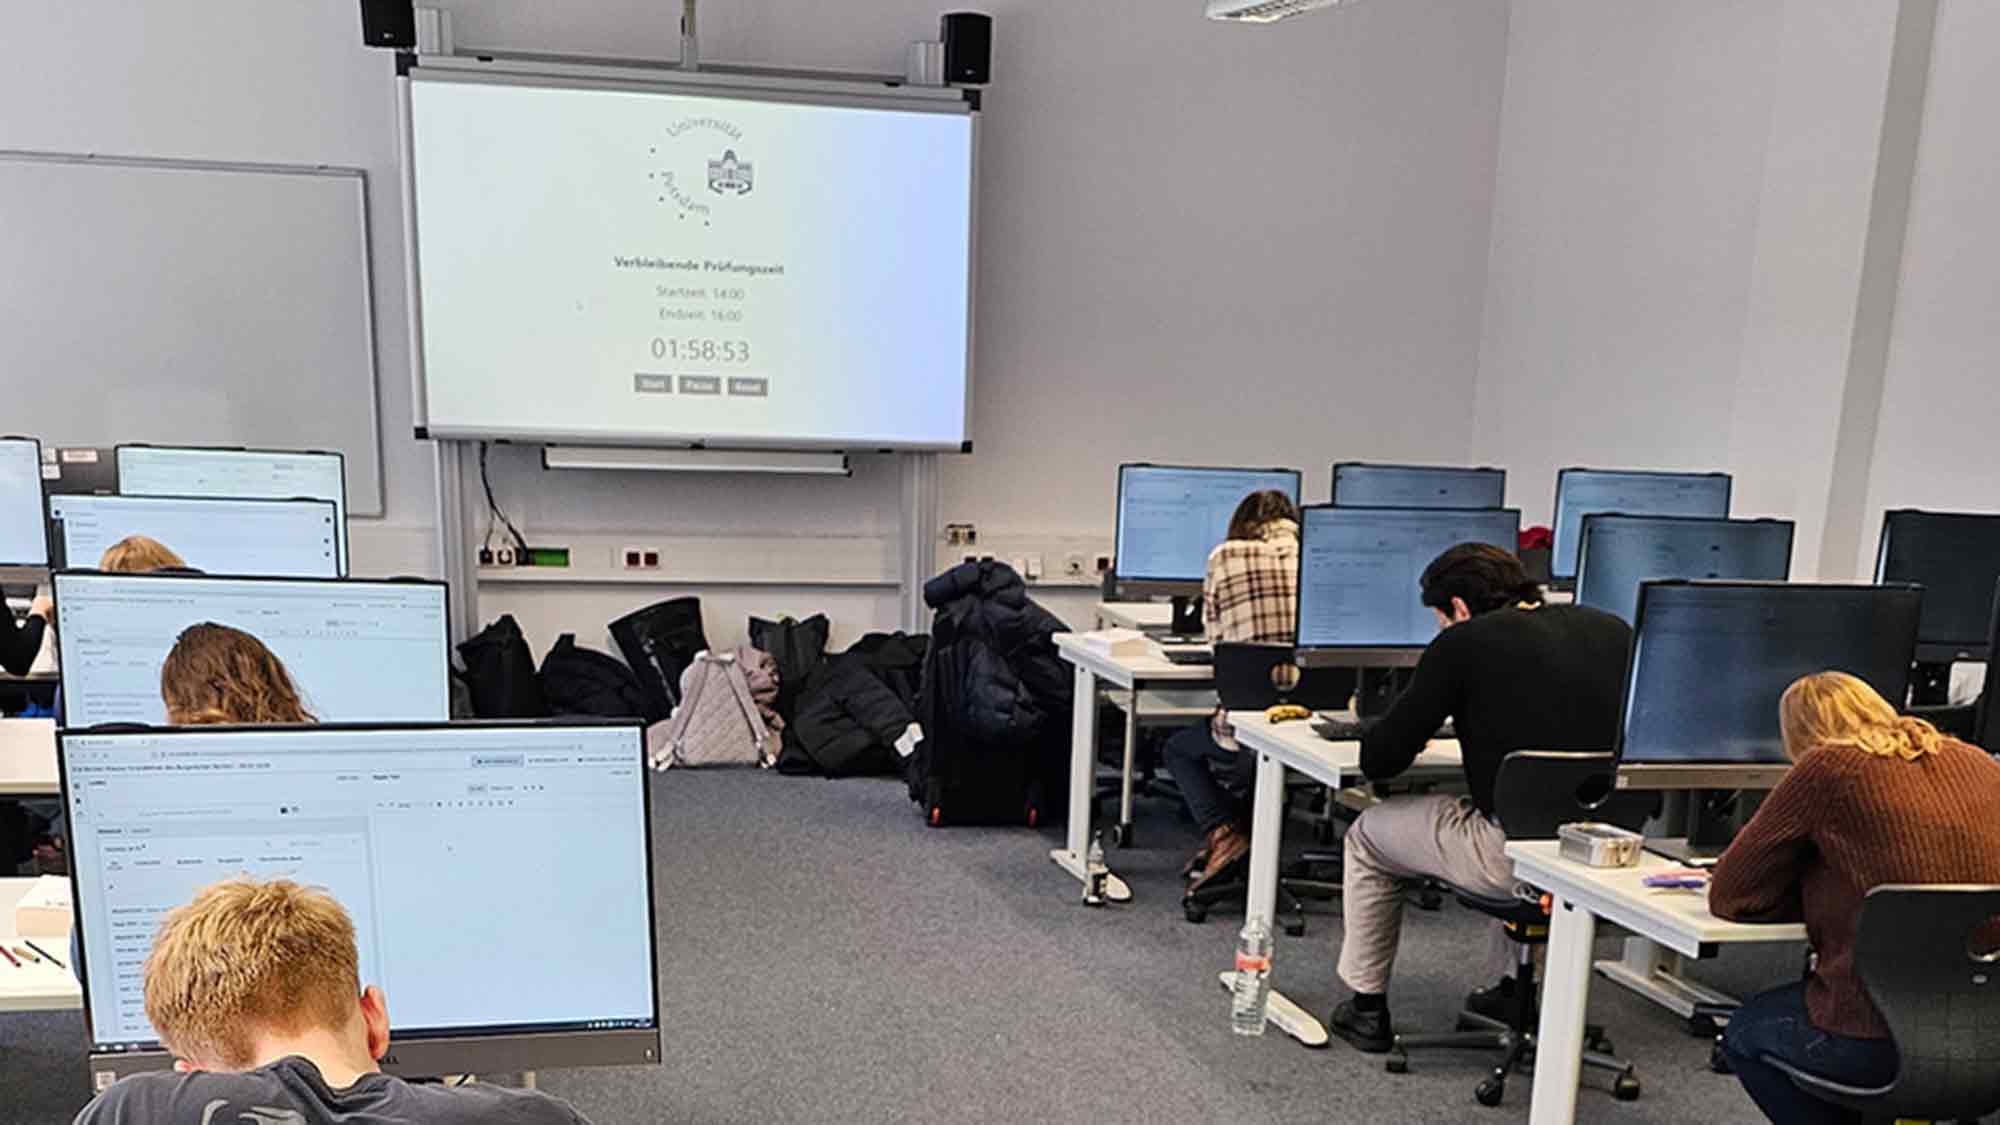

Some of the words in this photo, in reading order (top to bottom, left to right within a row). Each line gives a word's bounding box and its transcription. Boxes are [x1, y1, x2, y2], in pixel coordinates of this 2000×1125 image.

[614, 255, 699, 271] Verbleibende
[703, 259, 785, 276] Prüfungszeit
[650, 337, 750, 362] 01:58:53
